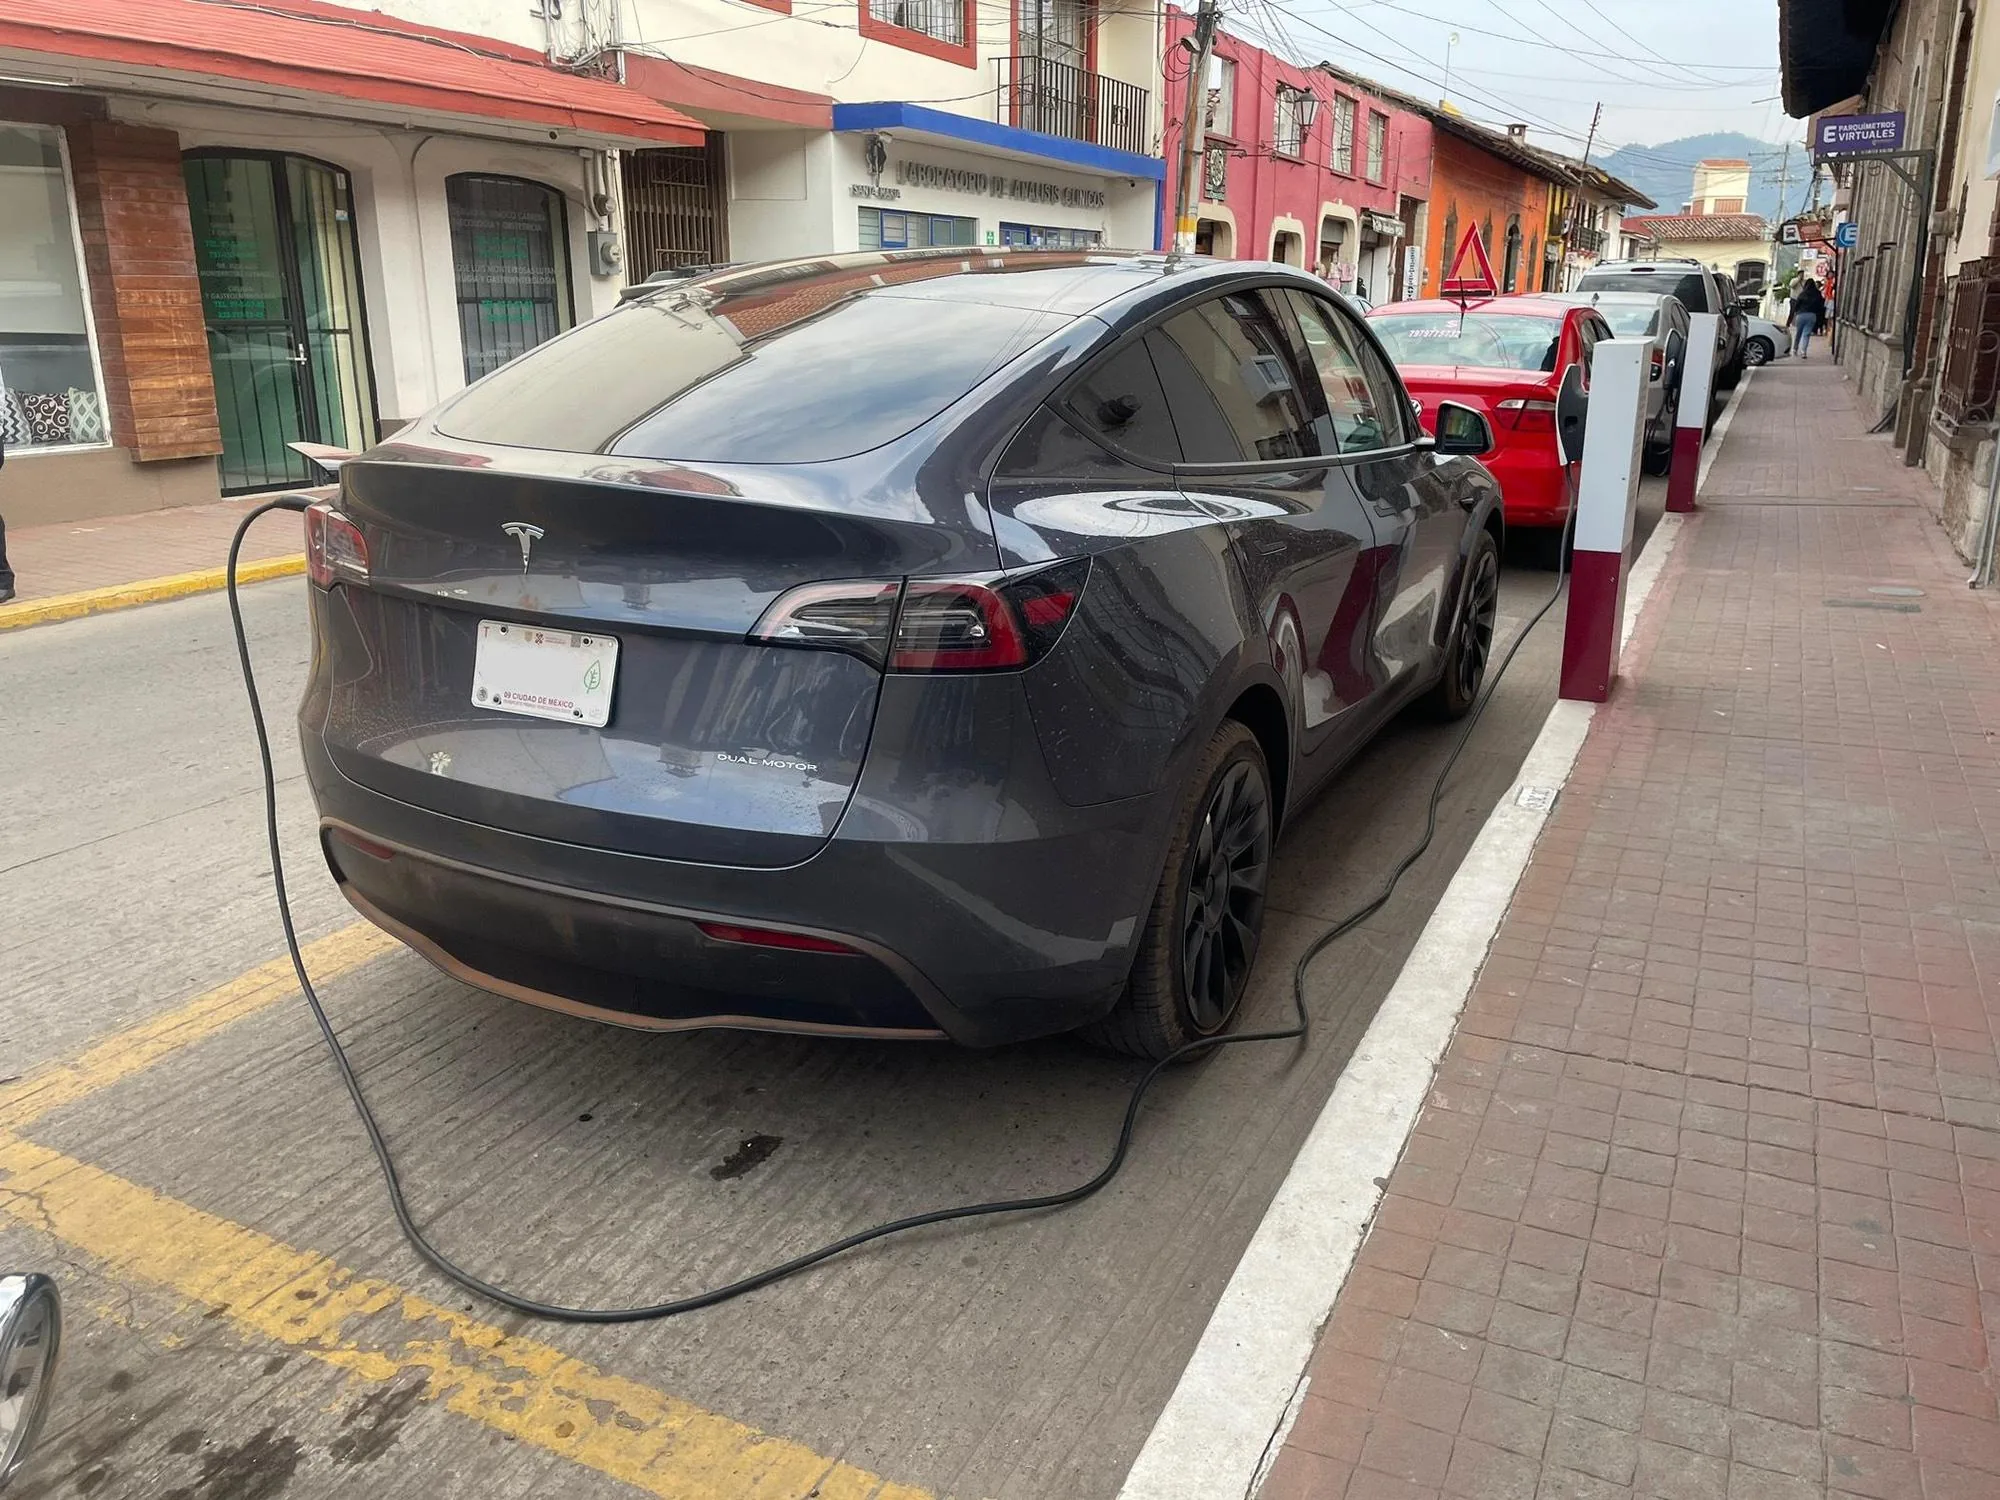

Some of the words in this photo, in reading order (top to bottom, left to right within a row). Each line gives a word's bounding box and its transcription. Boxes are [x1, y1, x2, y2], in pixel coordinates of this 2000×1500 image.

[1838, 128, 1896, 141] VIRTUALES
[503, 691, 511, 699] 09
[512, 692, 537, 703] CIUDAD
[537, 696, 547, 705] DE
[717, 754, 758, 765] DUAL
[762, 759, 818, 772] MOTOR
